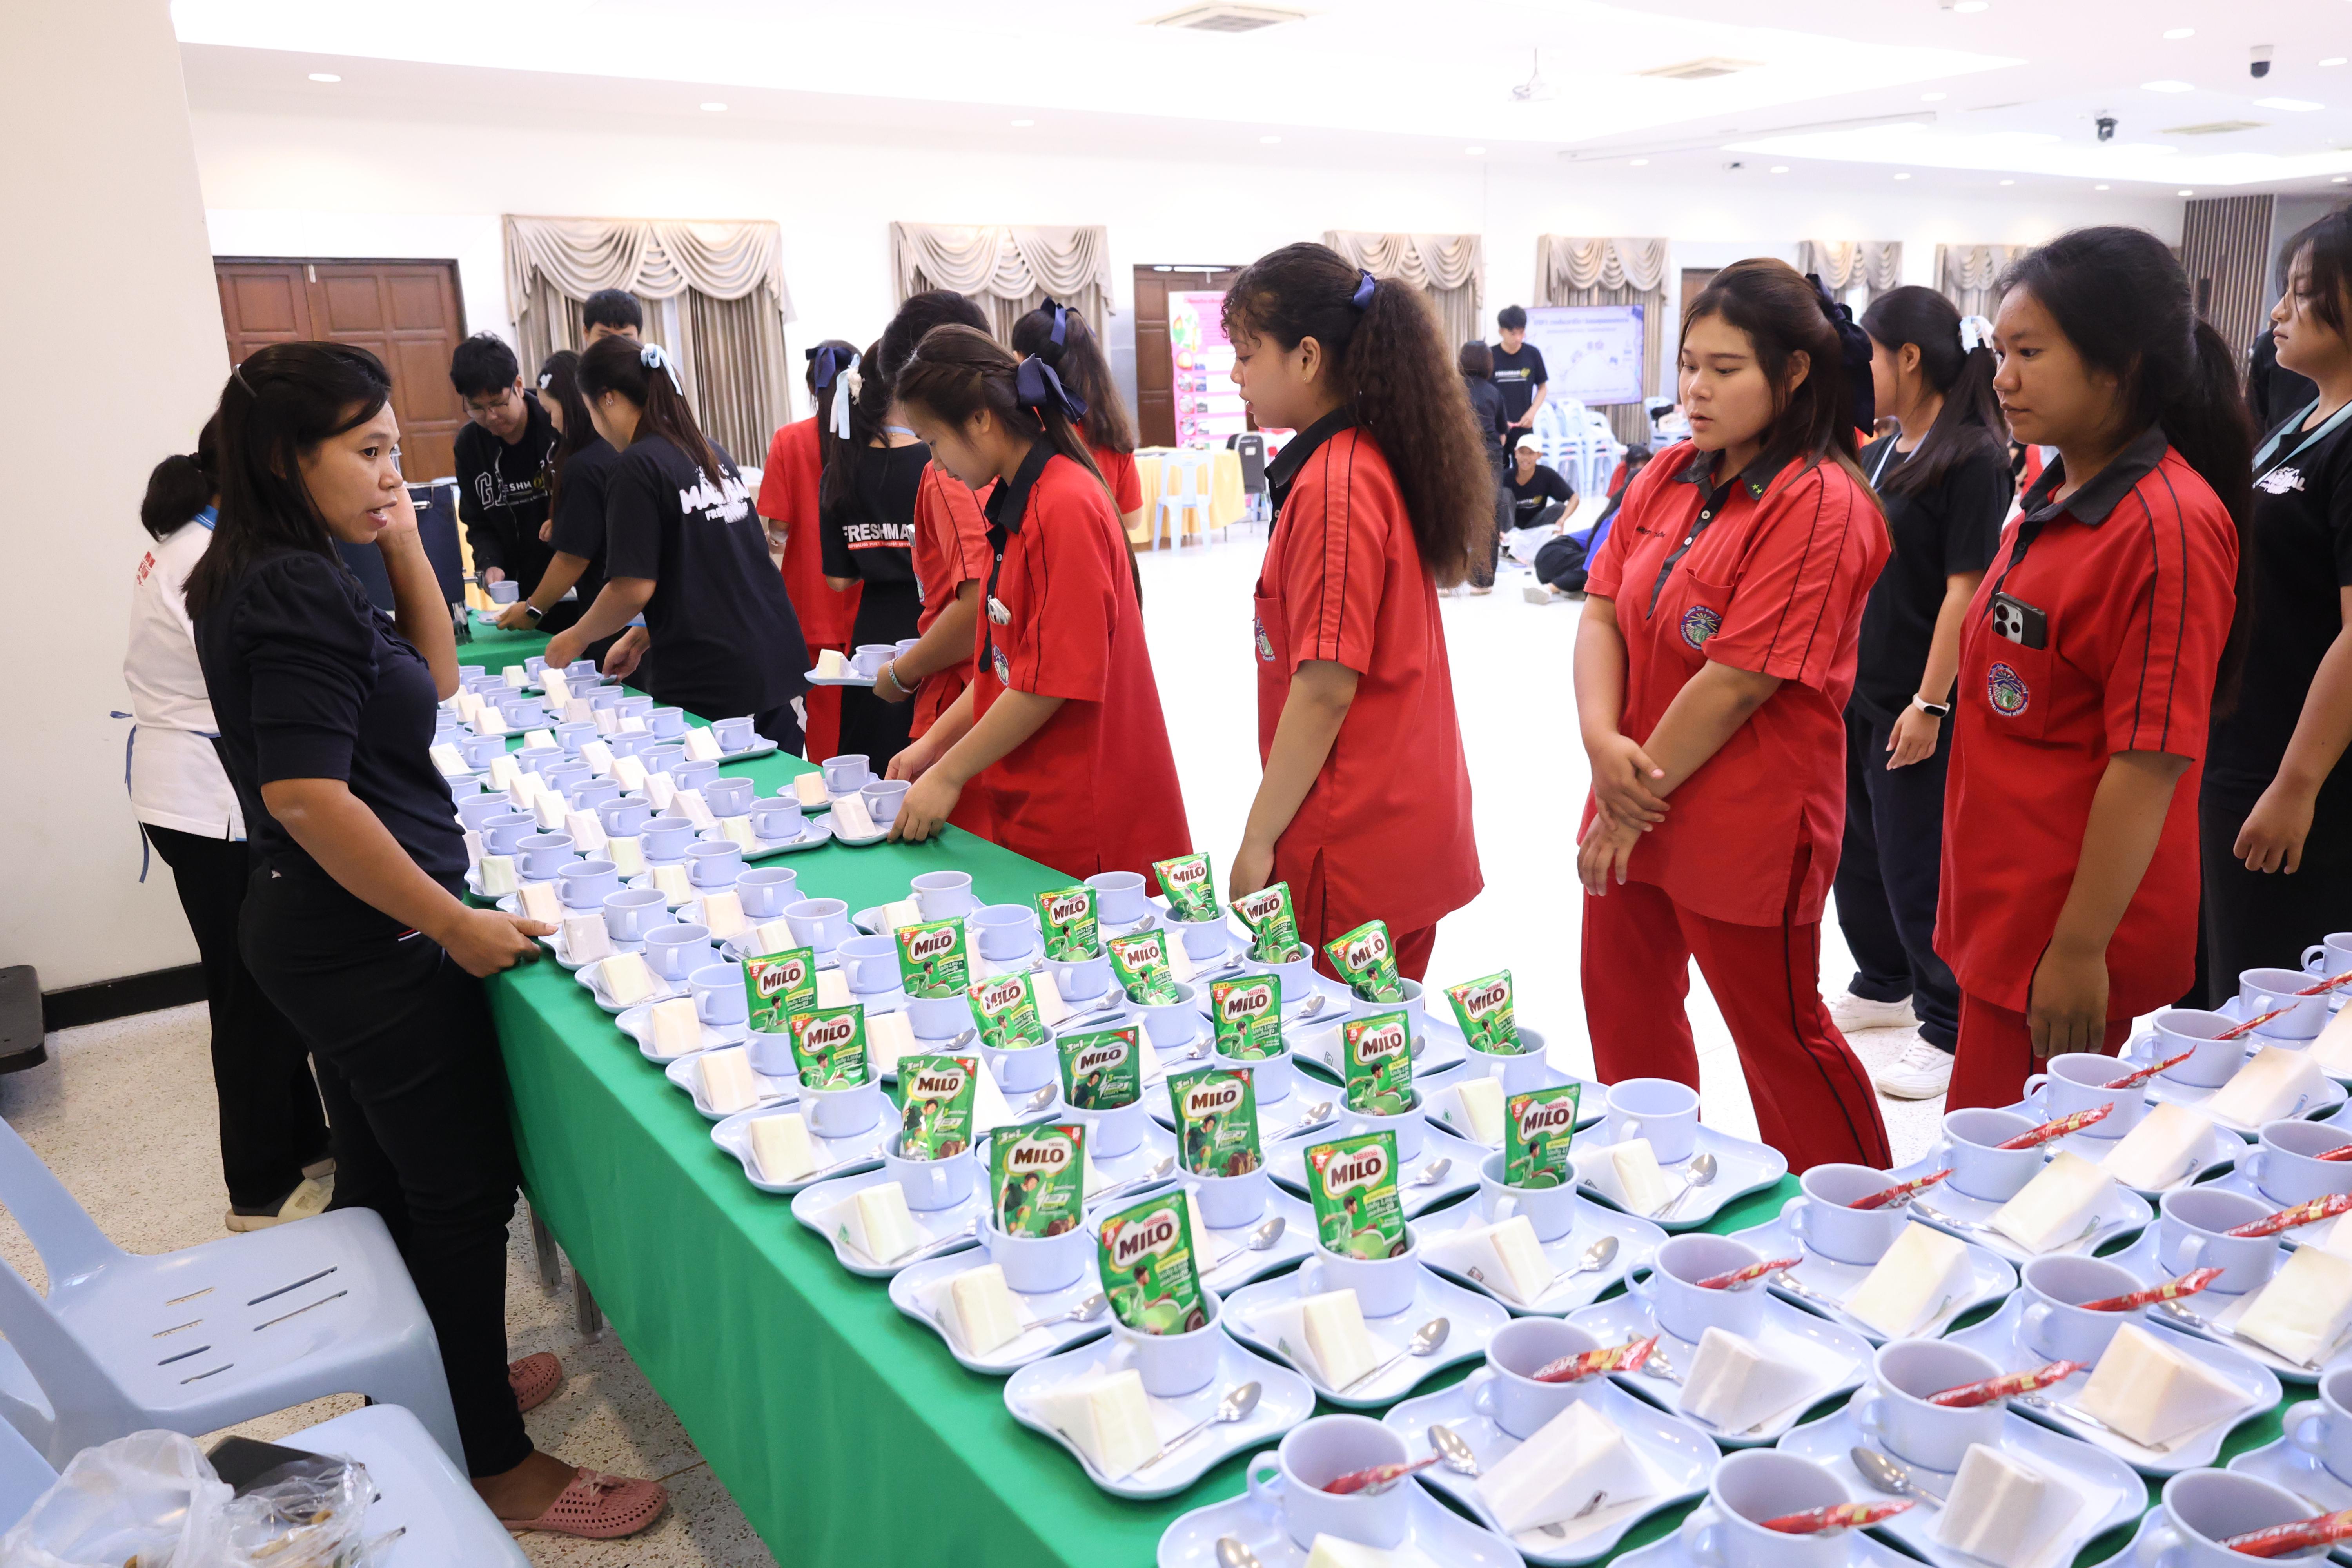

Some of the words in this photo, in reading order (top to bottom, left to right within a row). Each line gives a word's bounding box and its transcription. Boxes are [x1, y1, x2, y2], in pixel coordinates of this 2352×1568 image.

[1173, 866, 1205, 882] MILO
[1187, 861, 1201, 869] Nestlé
[1069, 895, 1083, 904] Nestlé
[1262, 893, 1277, 902] Nestlé
[1053, 900, 1085, 920] MILO
[1247, 898, 1279, 919] MILO
[933, 929, 950, 938] Nestlé
[915, 935, 952, 956] MILO
[1338, 947, 1344, 956] 5
[1127, 946, 1159, 965] MILO
[764, 968, 801, 991] MILO
[984, 986, 1020, 1010] MILO
[1247, 987, 1265, 997] Nestlé
[1468, 988, 1505, 1014] MILO
[1228, 994, 1267, 1015] MILO
[795, 1021, 803, 1029] 5
[808, 1024, 851, 1047] MILO
[1362, 1033, 1402, 1057] MILO
[1066, 1043, 1073, 1052] 3
[1078, 1039, 1083, 1048] 1
[907, 1062, 913, 1071] 3
[919, 1059, 925, 1068] 1
[1080, 1049, 1121, 1070] MILO
[918, 1077, 959, 1091] MILO
[1176, 1081, 1183, 1089] 3
[1189, 1076, 1194, 1085] 1
[1191, 1090, 1236, 1110] MILO
[1524, 1109, 1570, 1134] MILO
[1001, 1132, 1009, 1142] 3
[1015, 1128, 1022, 1138] 1
[1014, 1148, 1064, 1165] MILO
[1331, 1158, 1381, 1188] MILO
[1119, 1223, 1173, 1260] MILO
